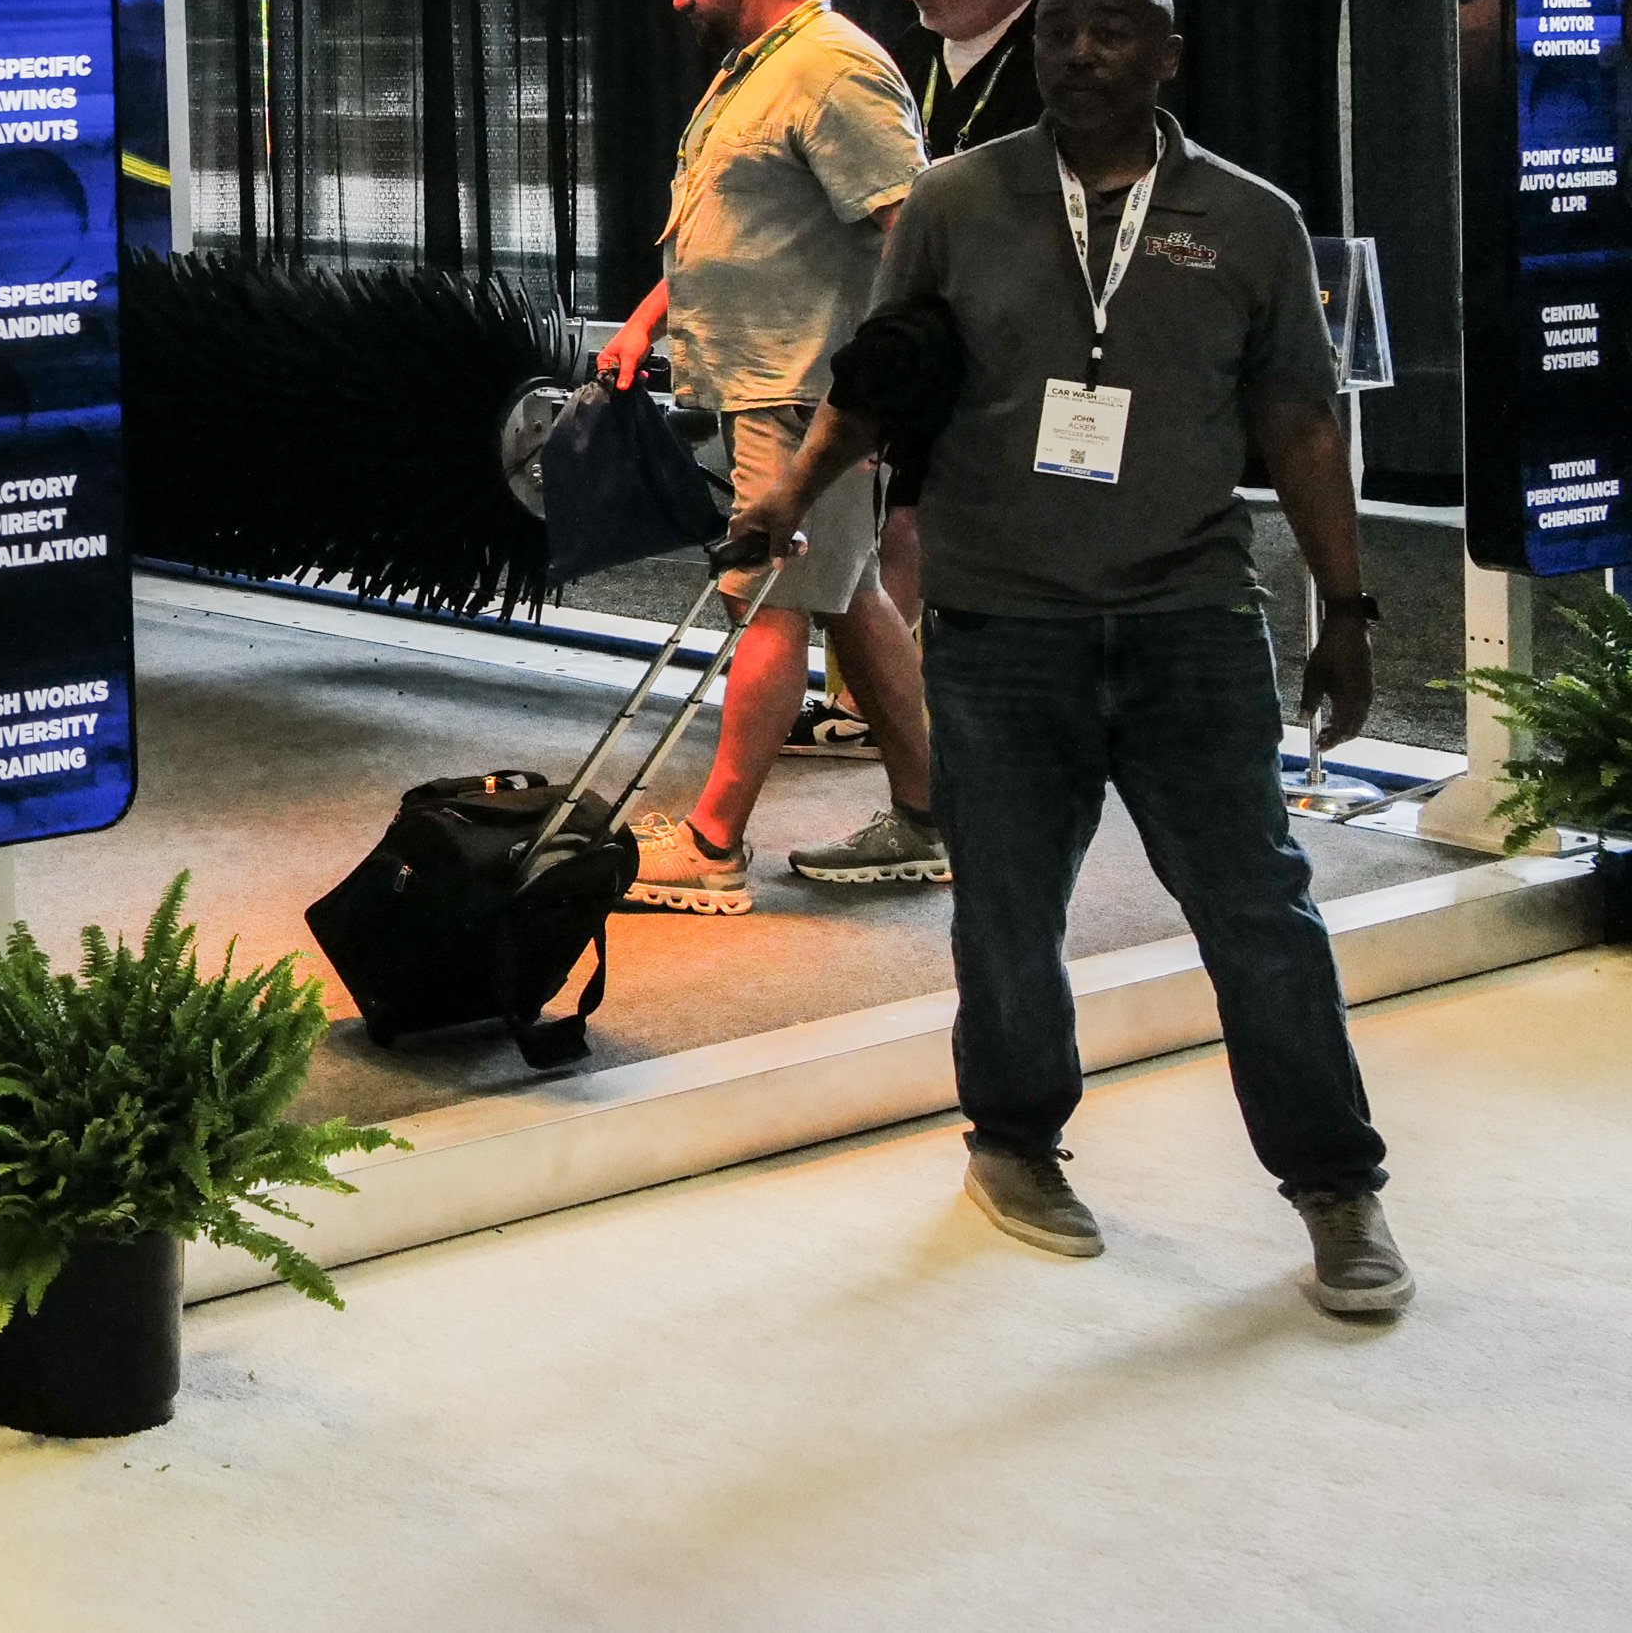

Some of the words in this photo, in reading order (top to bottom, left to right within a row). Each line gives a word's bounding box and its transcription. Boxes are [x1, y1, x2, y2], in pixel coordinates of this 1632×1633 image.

[1538, 16, 1549, 33] &
[1549, 15, 1594, 33] MOTOR
[1533, 39, 1600, 56] CONTROLS
[1522, 148, 1561, 167] POINT
[1562, 148, 1580, 165] OF
[1580, 146, 1614, 164] SALE
[1520, 173, 1554, 192] AUTO
[1556, 170, 1617, 190] CASHIERS
[1551, 197, 1561, 213] &
[1562, 195, 1587, 213] LPR
[1542, 303, 1599, 323] CENTRAL
[1544, 326, 1597, 347] VACUUM
[1542, 350, 1599, 372] SYSTEMS
[1051, 387, 1070, 397] CAR
[1072, 390, 1097, 400] WASH
[1068, 422, 1097, 432] ACKER
[1071, 414, 1095, 423] JOHN
[1549, 459, 1596, 480] TRITON
[1526, 480, 1620, 507] PERFORMANCE
[1538, 504, 1609, 530] CHEMISTRY
[24, 680, 110, 711] WORKS
